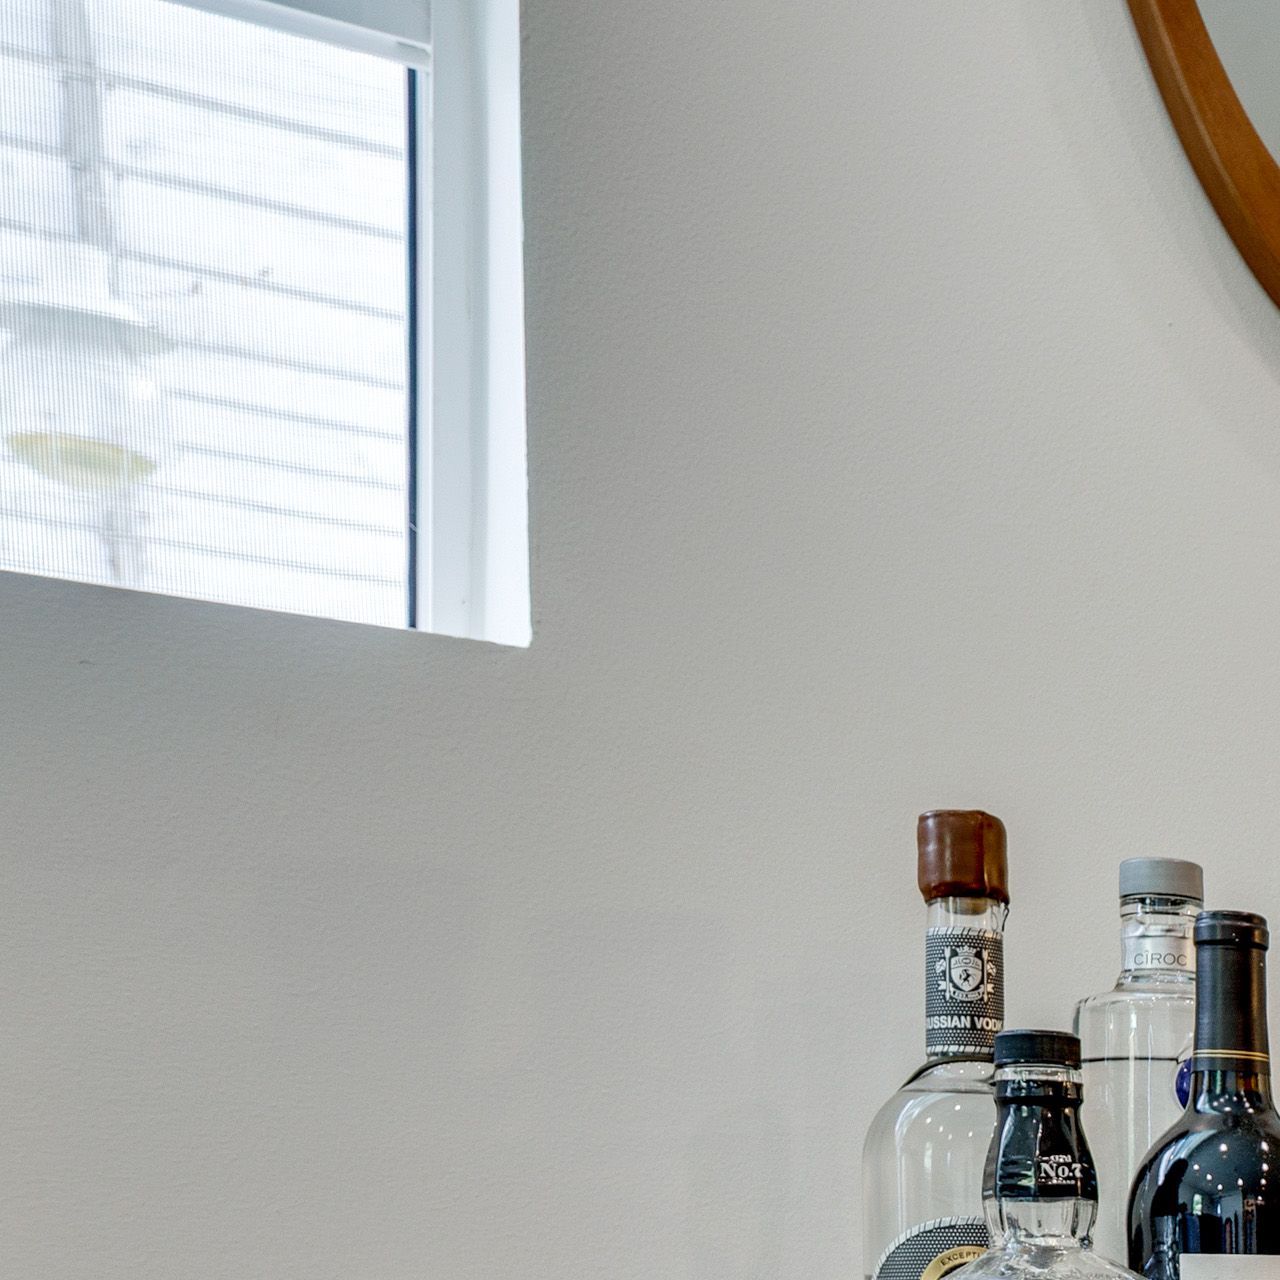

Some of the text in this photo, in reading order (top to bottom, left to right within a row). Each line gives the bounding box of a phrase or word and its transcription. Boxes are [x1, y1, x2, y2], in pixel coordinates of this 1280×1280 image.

[927, 1015, 970, 1029] USSIAN
[1040, 1162, 1083, 1178] No.7
[941, 1251, 980, 1266] EXCEPTI
